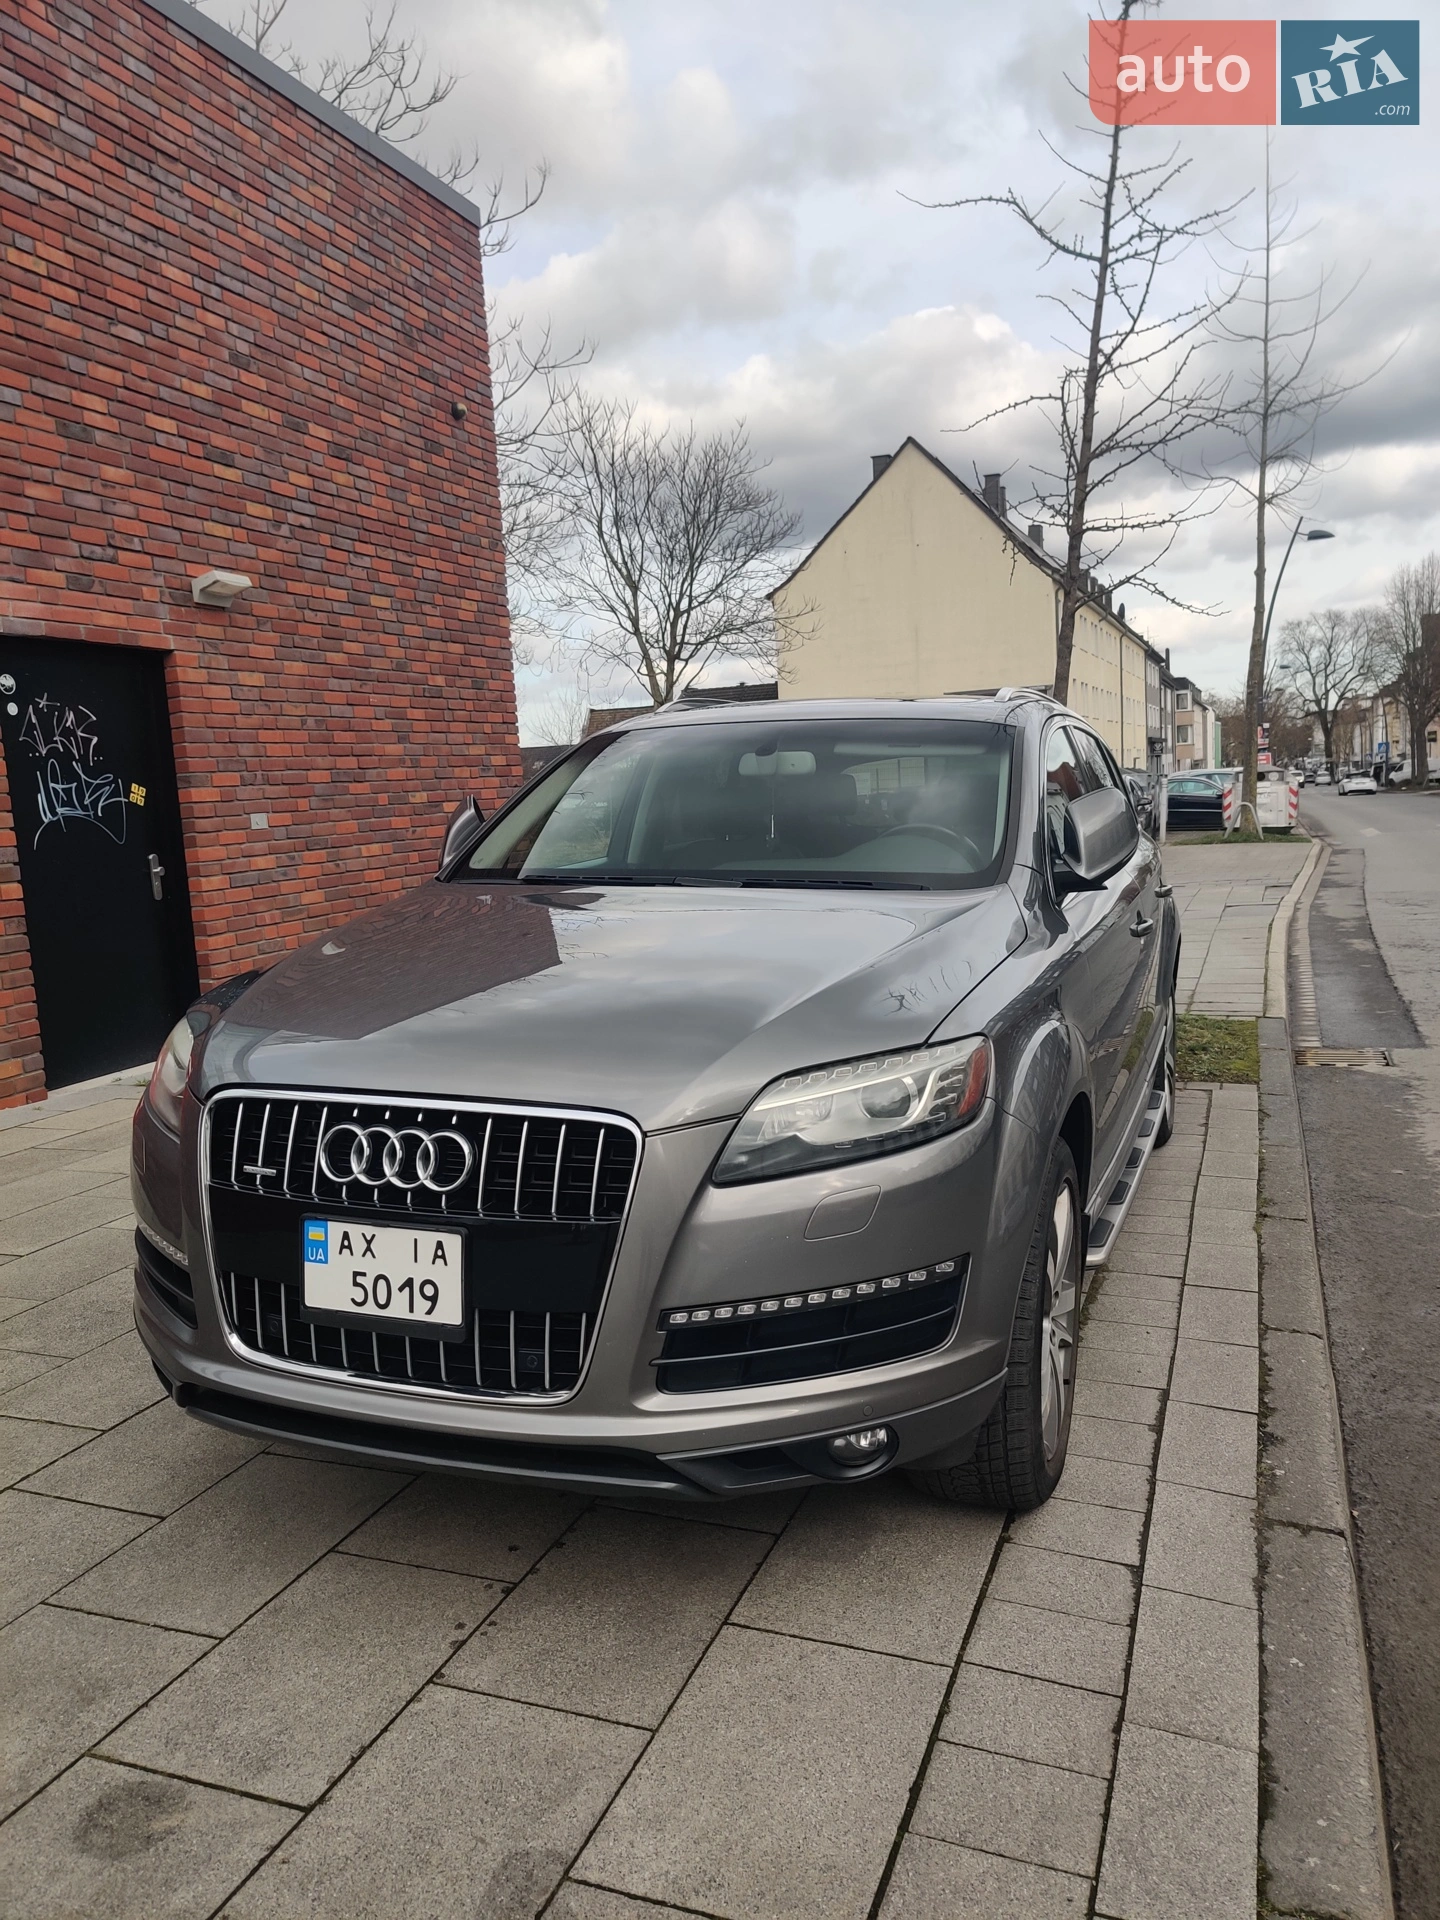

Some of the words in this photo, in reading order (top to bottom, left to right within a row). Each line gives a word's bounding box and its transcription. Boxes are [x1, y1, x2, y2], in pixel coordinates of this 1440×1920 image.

[308, 1246, 326, 1262] UA
[338, 1230, 377, 1259] AX
[414, 1237, 448, 1267] IA
[350, 1270, 440, 1316] 5019
